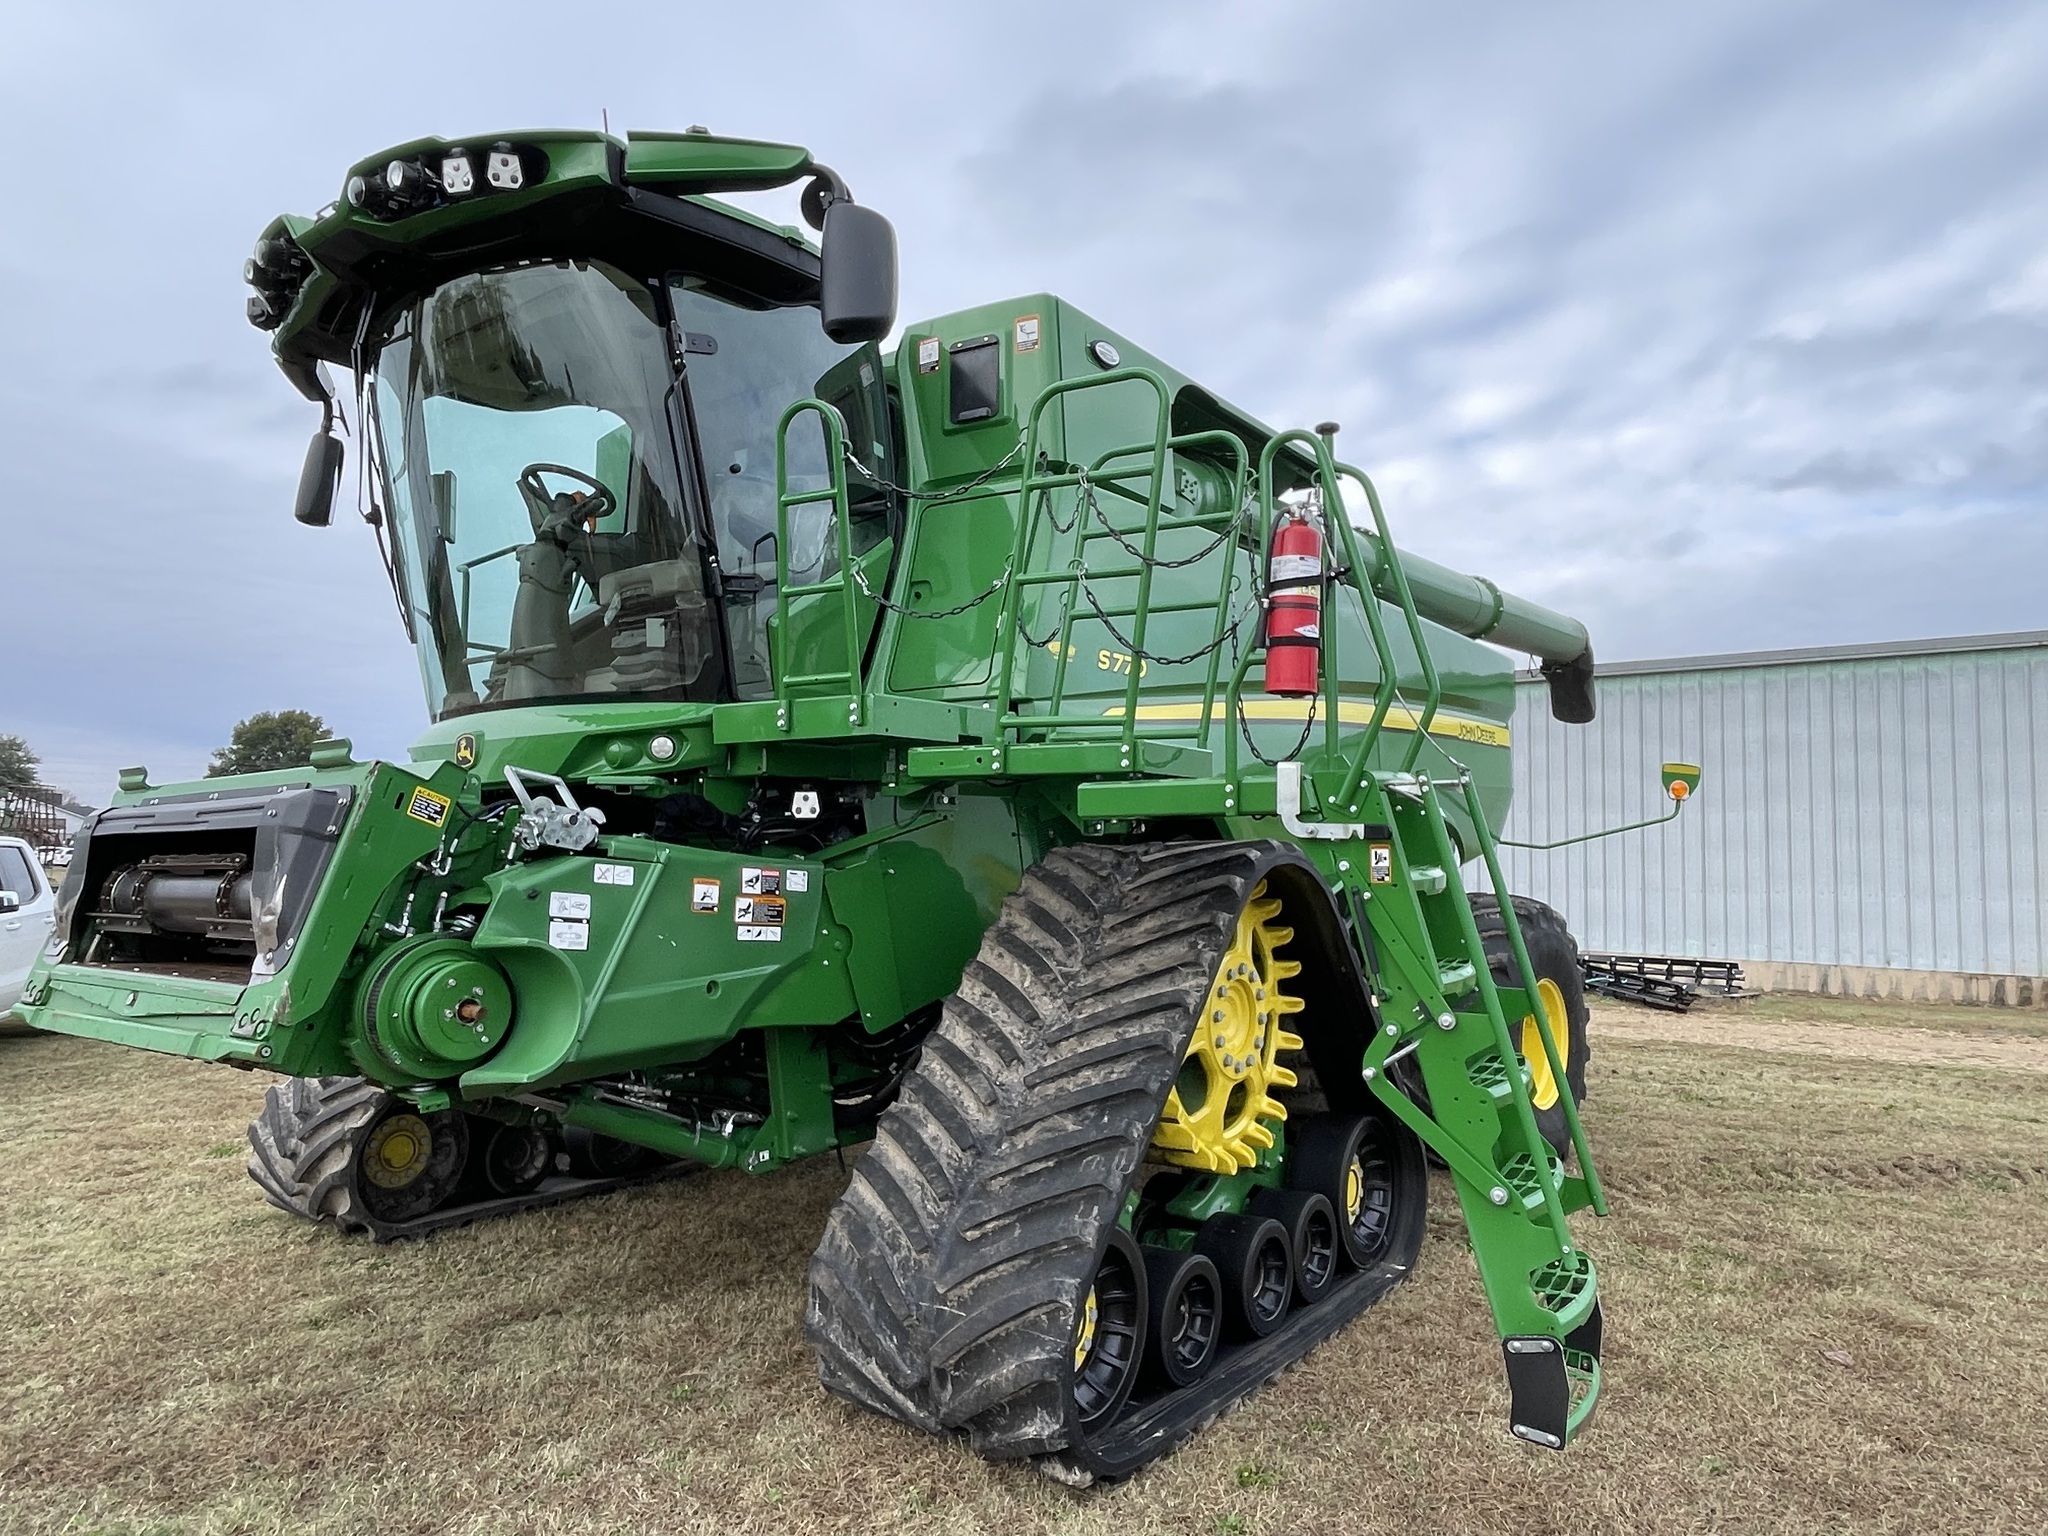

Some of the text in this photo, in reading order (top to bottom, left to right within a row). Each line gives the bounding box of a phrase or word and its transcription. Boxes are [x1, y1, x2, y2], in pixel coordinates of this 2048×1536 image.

[1458, 721, 1497, 744] JOHN DEERE
[422, 789, 449, 804] CAUTION
